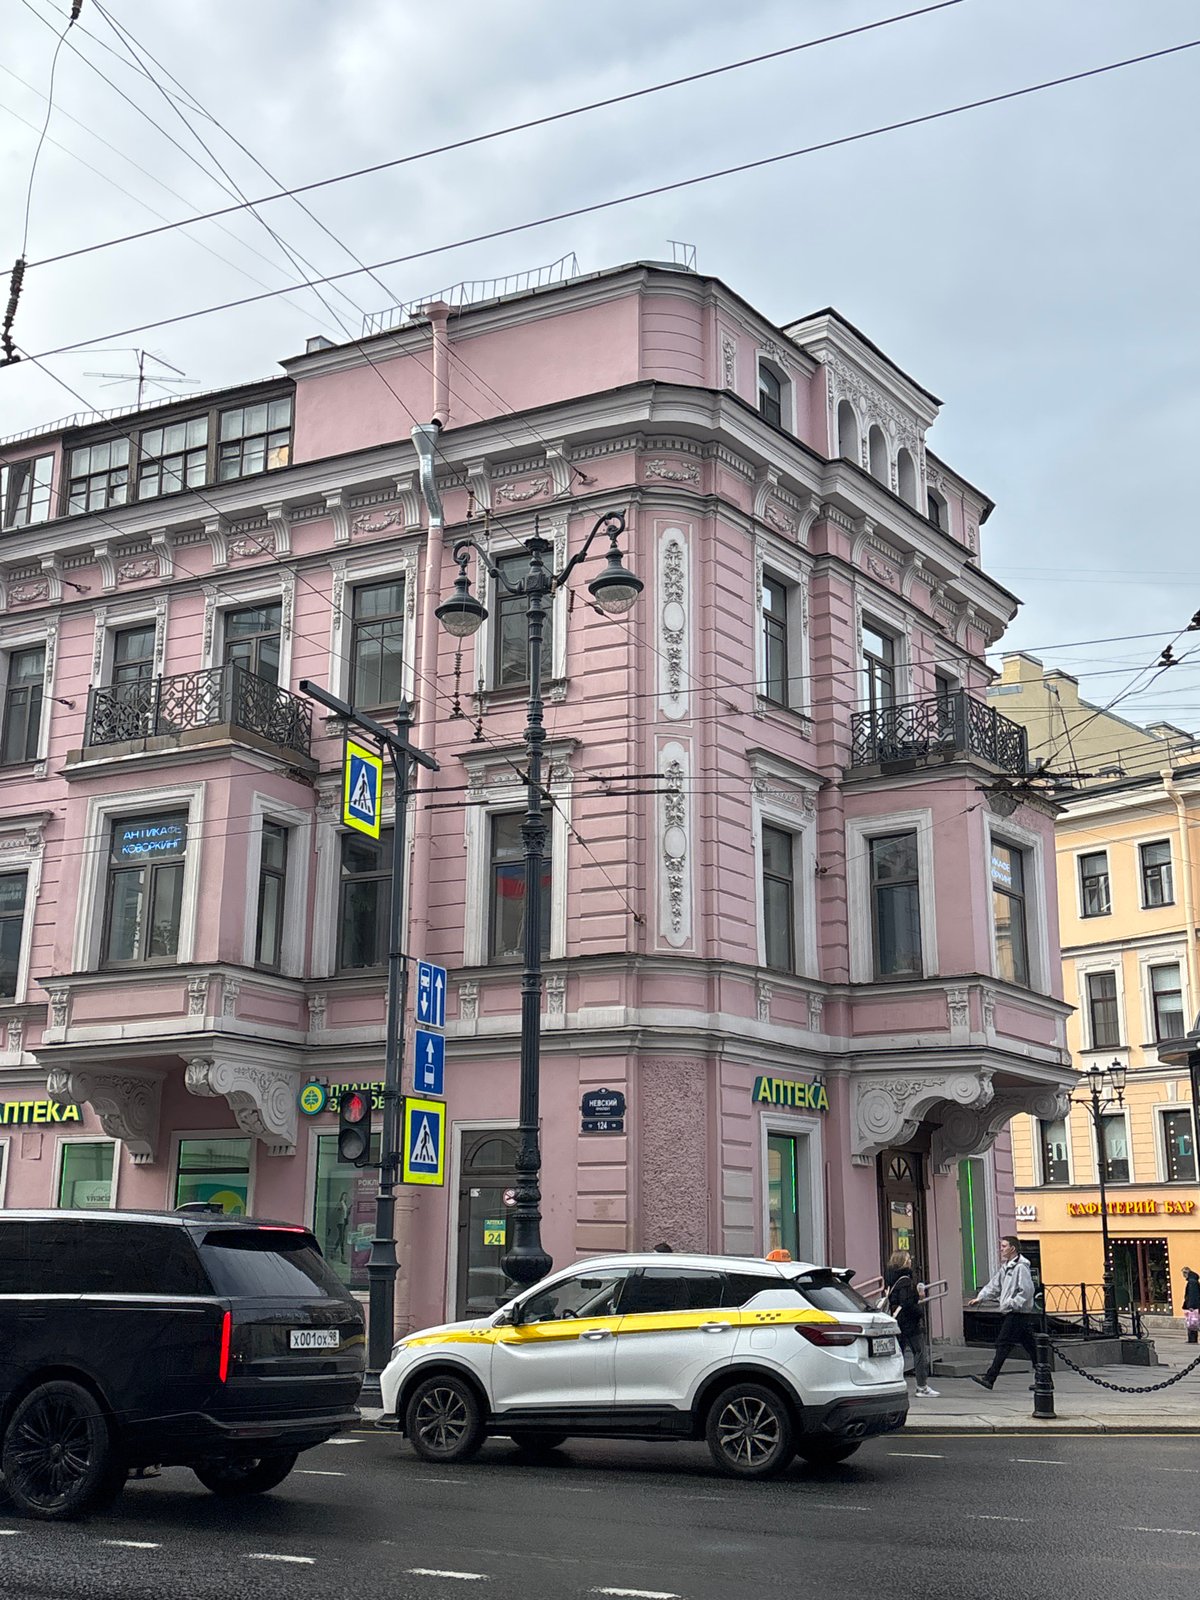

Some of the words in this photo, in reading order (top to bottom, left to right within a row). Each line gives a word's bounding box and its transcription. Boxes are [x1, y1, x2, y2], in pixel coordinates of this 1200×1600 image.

[122, 838, 182, 855] КОВОРКИНГ
[758, 1077, 829, 1110] АПТЕКА
[588, 1098, 618, 1107] НЕВСКИЙ
[0, 1100, 80, 1124] ПТЕКА
[597, 1121, 608, 1130] 124
[1016, 1205, 1036, 1215] КИ
[1164, 1200, 1194, 1214] БАР
[487, 1233, 502, 1244] 24
